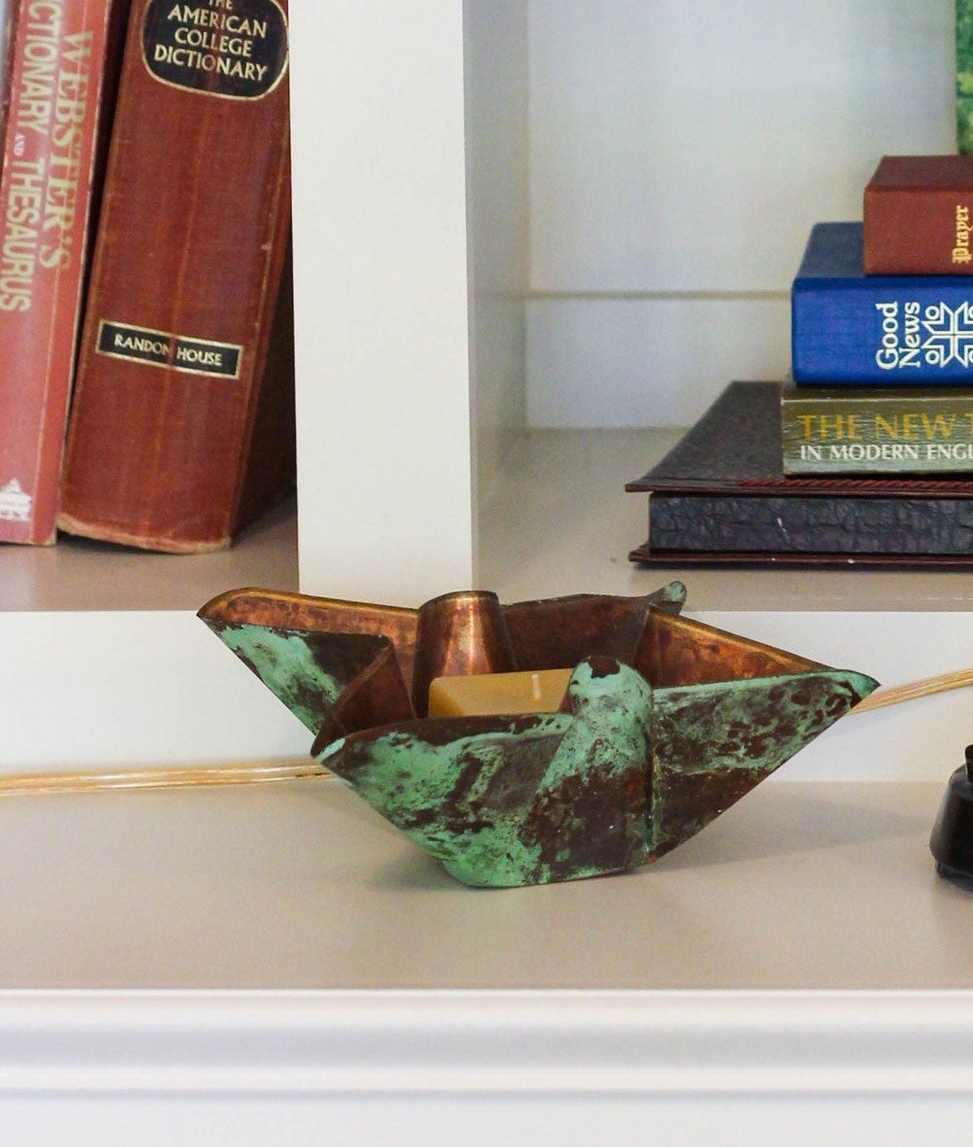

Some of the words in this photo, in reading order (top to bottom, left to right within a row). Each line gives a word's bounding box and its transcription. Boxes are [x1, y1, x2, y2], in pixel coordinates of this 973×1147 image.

[166, 4, 268, 39] AMERICAN
[174, 27, 253, 58] COLLEGE
[154, 44, 268, 82] DICTIONARY
[13, 134, 26, 156] AND
[39, 30, 94, 270] WEBSTER'S
[0, 157, 46, 313] THESAURUS
[951, 204, 973, 265] Prayer
[875, 301, 899, 370] Good
[898, 301, 921, 369] News
[176, 346, 223, 366] HOUSE
[797, 412, 864, 441] THE
[874, 412, 957, 440] NEW
[800, 444, 822, 461] IN
[829, 444, 920, 461] MODERN
